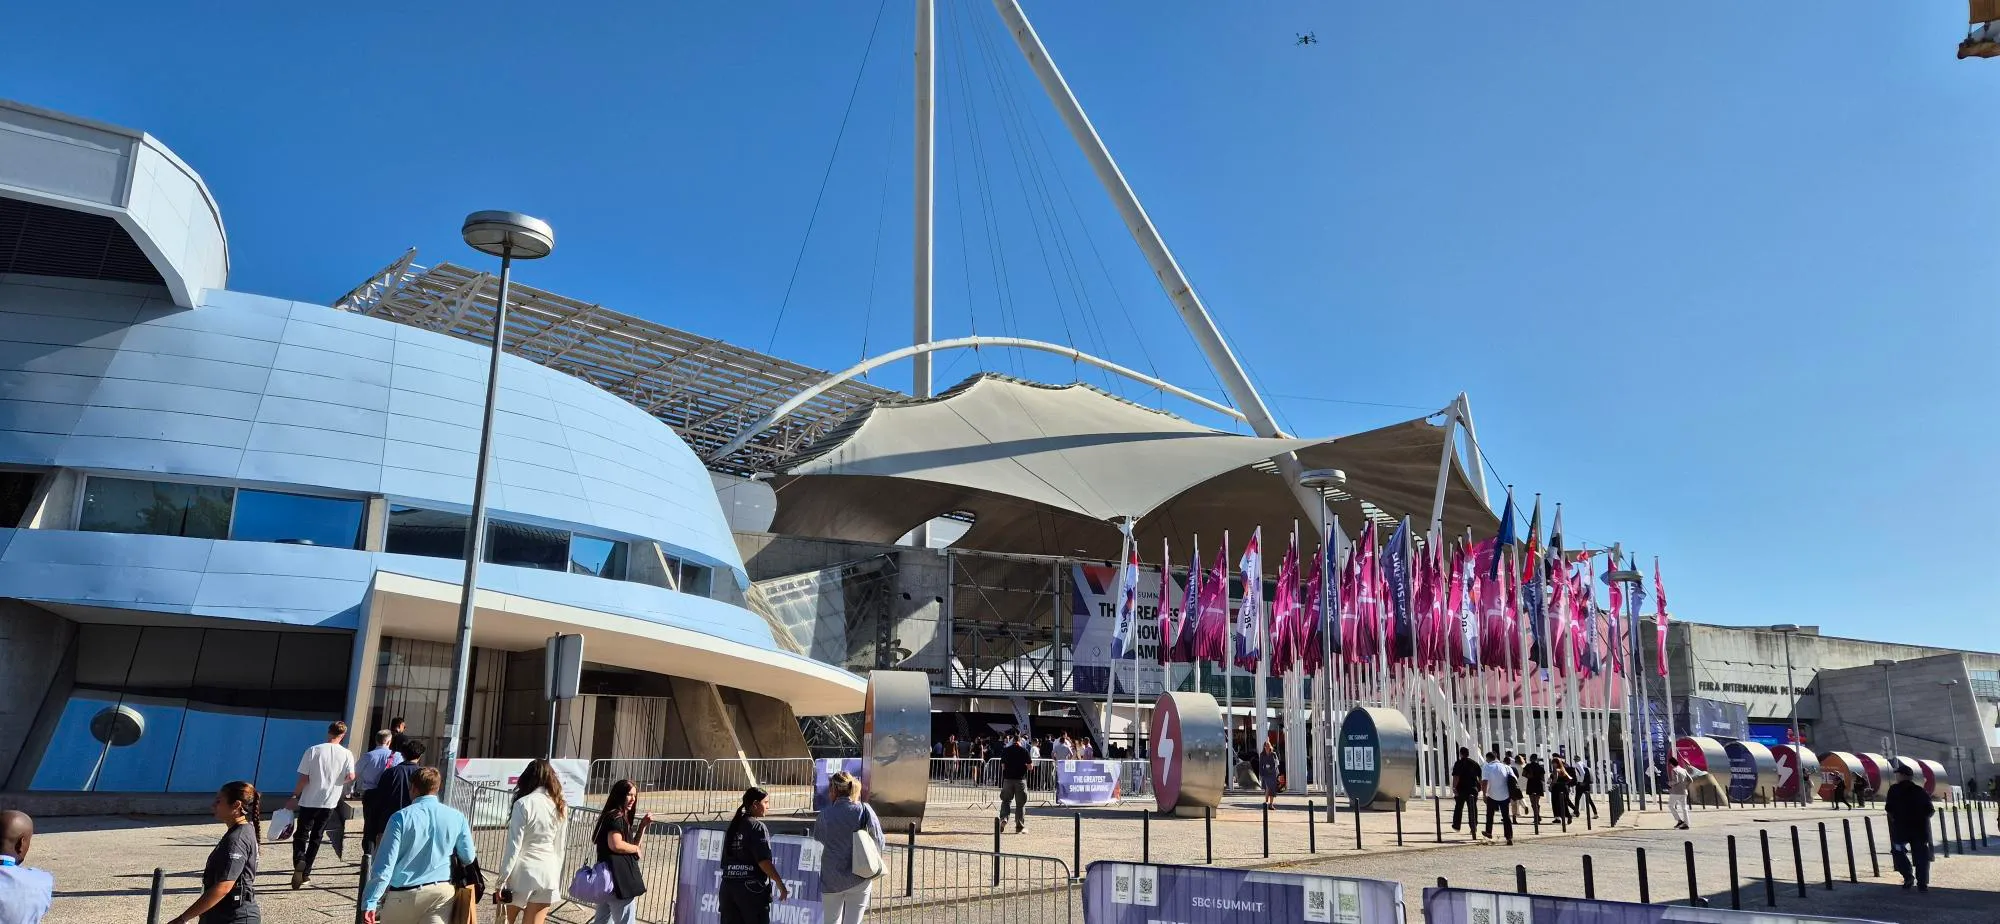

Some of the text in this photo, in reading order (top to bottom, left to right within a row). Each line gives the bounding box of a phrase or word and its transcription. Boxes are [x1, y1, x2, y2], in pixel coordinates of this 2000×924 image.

[1137, 592, 1159, 600] SUMM
[1099, 603, 1116, 619] TH
[1244, 610, 1252, 629] SBC
[1698, 681, 1720, 692] FEIRA
[1723, 682, 1778, 696] INTERNACIONAL
[1780, 686, 1789, 696] DE
[1073, 775, 1106, 783] THE GREATEST
[1192, 896, 1262, 913] SBC SUMMIT
